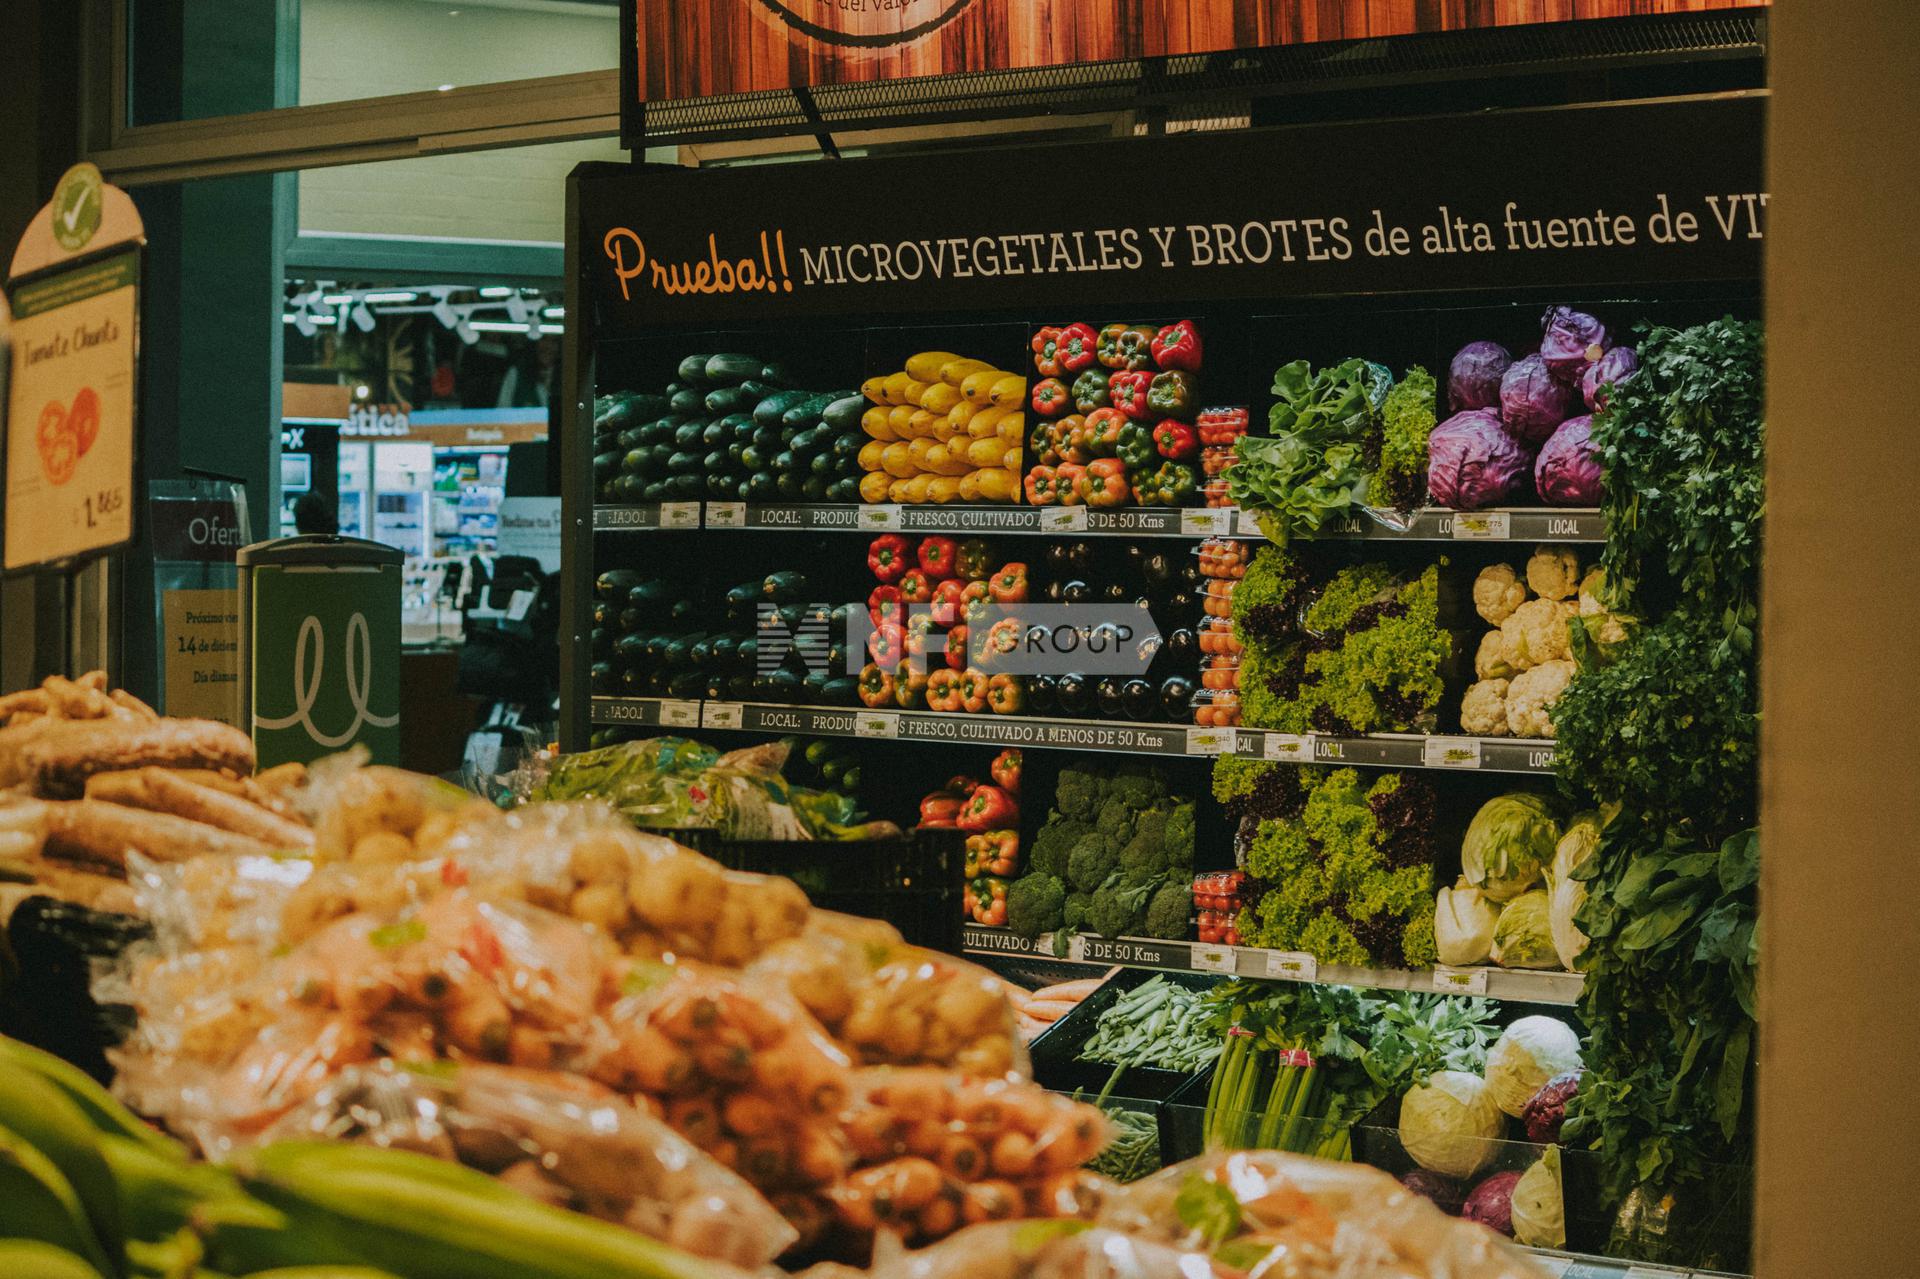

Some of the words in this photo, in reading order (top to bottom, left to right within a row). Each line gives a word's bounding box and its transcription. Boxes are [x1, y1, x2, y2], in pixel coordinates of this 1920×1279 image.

[604, 227, 793, 301] Prueba!!
[799, 227, 1143, 286] MICROVEGETALES
[1150, 226, 1176, 268] Y
[1188, 217, 1353, 267] BROTES
[1364, 209, 1411, 258] de
[1422, 205, 1496, 256] alta
[1504, 202, 1638, 251] fuente
[1648, 194, 1700, 244] de
[961, 513, 1034, 528] CULTIVADO
[1099, 514, 1116, 529] DE
[1119, 514, 1135, 529] 50
[1138, 514, 1165, 529] Kms
[1548, 519, 1580, 535] LOCAL
[178, 636, 196, 655] 14
[960, 724, 1033, 741] CULTIVADO
[1036, 730, 1045, 742] A
[1048, 730, 1094, 744] MENOS
[1097, 731, 1115, 745] DE
[1117, 731, 1134, 746] 50
[1137, 732, 1163, 747] Kms
[1095, 943, 1112, 958] DE
[1115, 944, 1131, 960] 50
[1134, 945, 1160, 962] Kms
